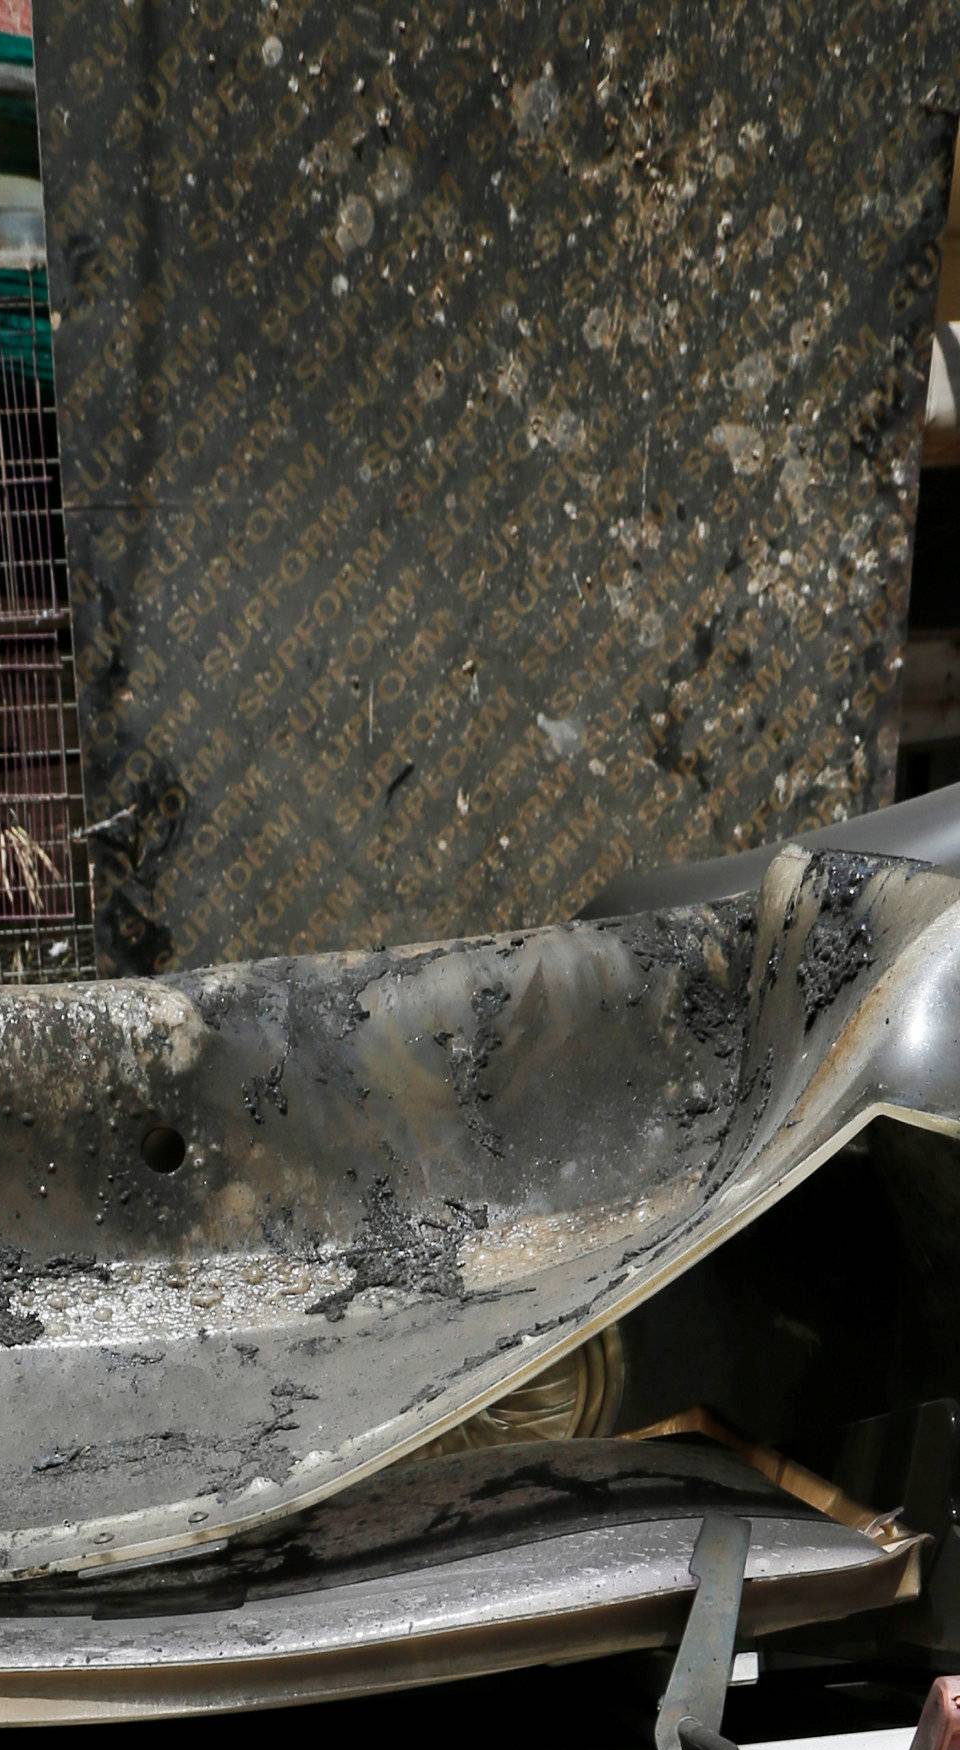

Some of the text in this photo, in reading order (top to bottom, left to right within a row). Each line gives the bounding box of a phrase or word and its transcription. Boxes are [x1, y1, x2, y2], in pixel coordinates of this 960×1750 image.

[165, 436, 328, 647] SUPFORM
[199, 480, 361, 687] SUPFORM
[233, 522, 394, 725] SUPFORM
[266, 564, 426, 764] SUPFORM
[361, 683, 518, 873] SUPFORM
